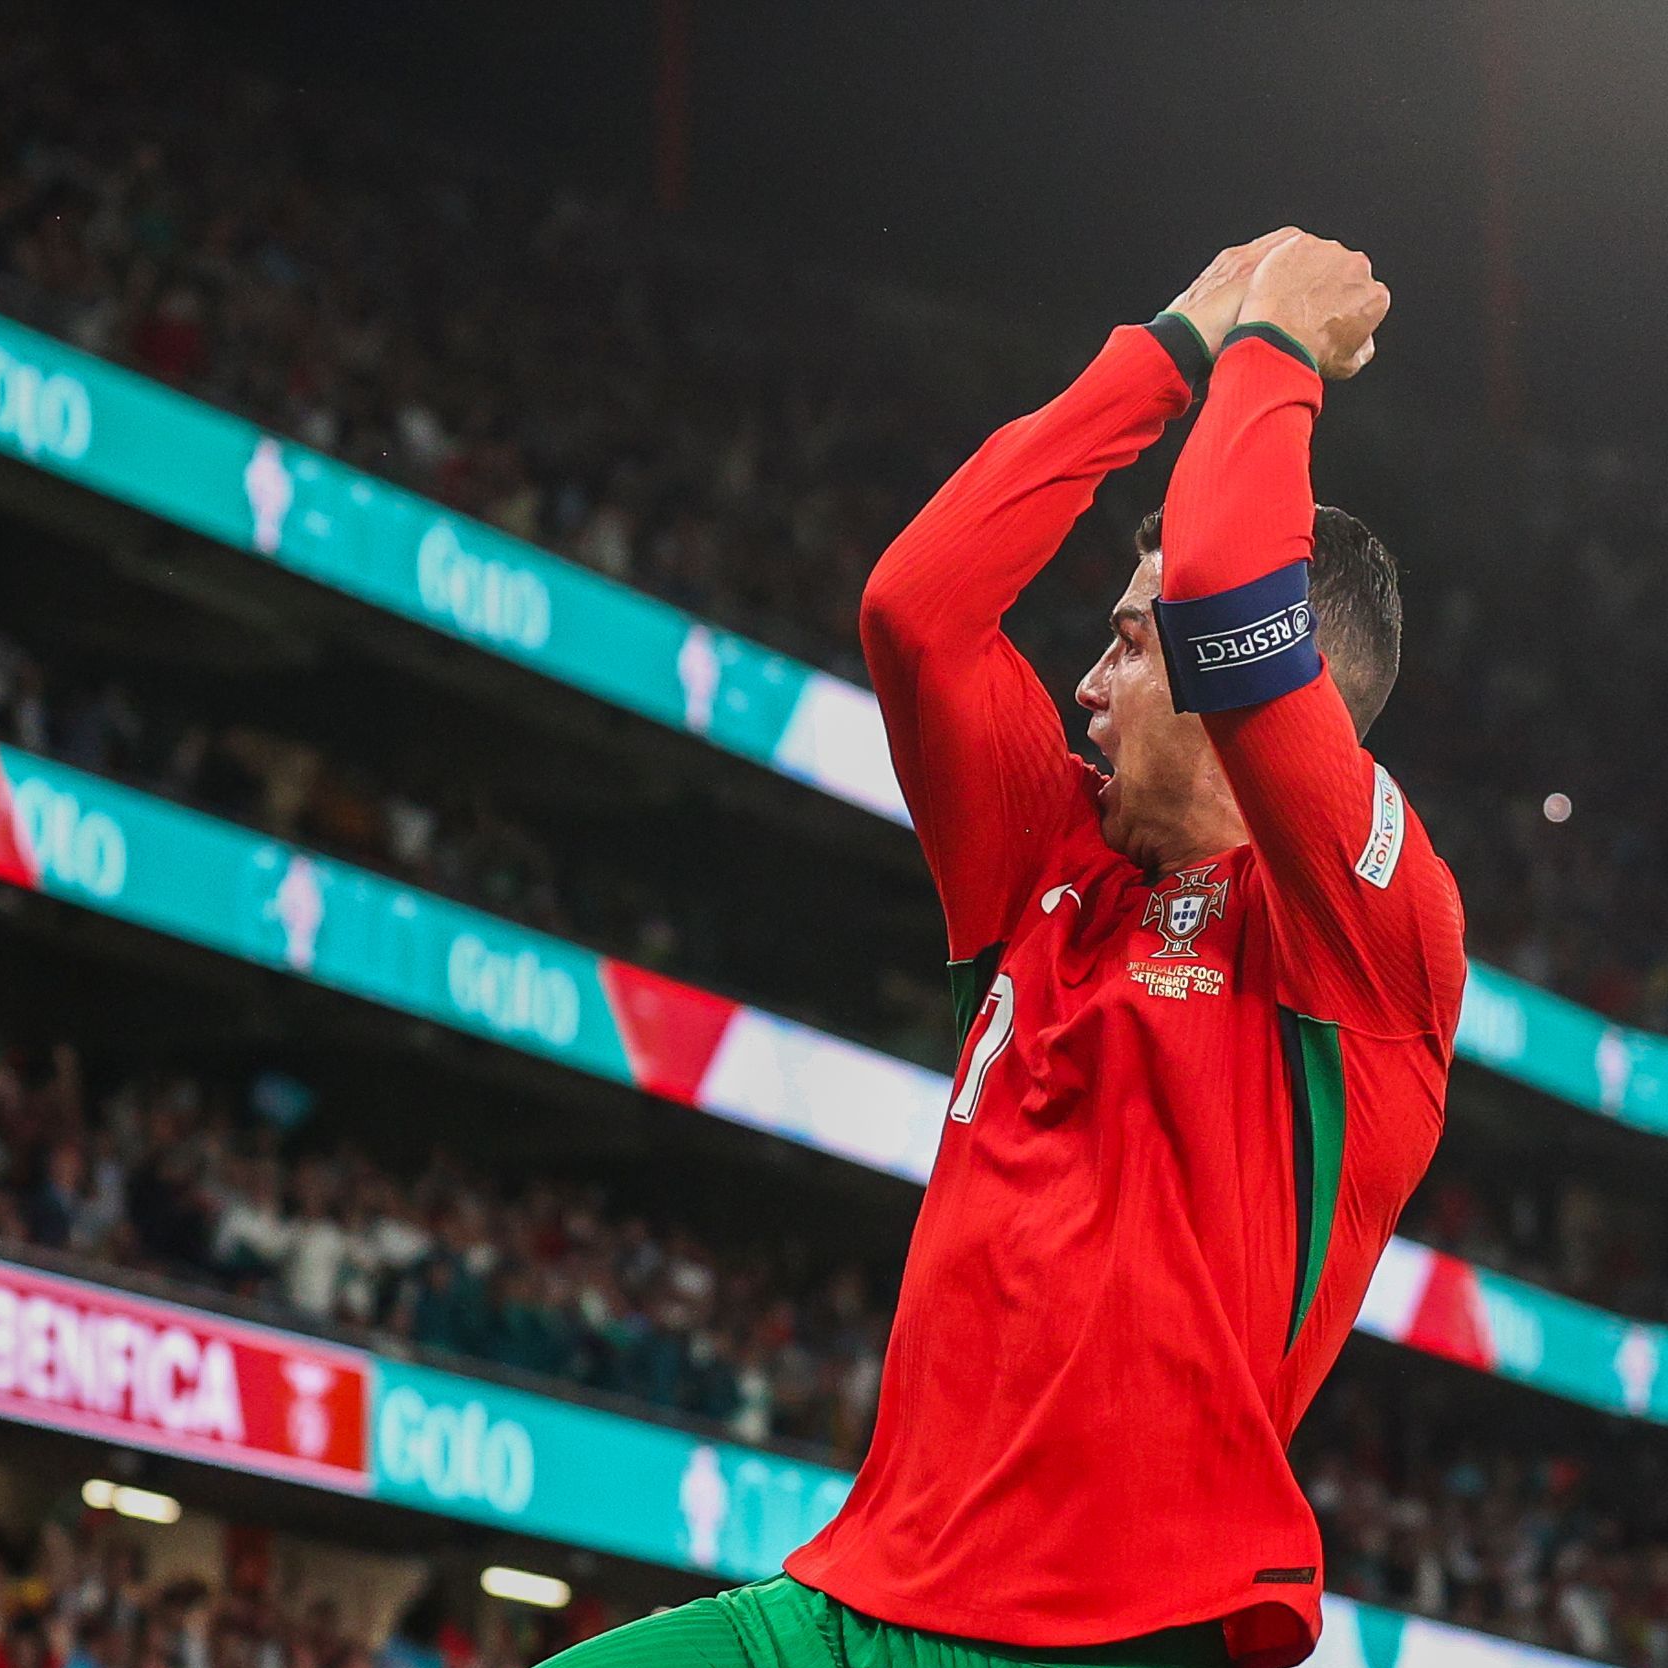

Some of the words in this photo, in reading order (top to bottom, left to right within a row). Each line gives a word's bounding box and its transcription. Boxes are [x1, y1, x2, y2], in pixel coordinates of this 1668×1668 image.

[1196, 617, 1292, 664] RESPECT
[1131, 970, 1188, 988] SETEMBRO
[1193, 979, 1220, 996] 2024
[1148, 983, 1187, 1000] LISBOA
[950, 972, 1014, 1124] 7
